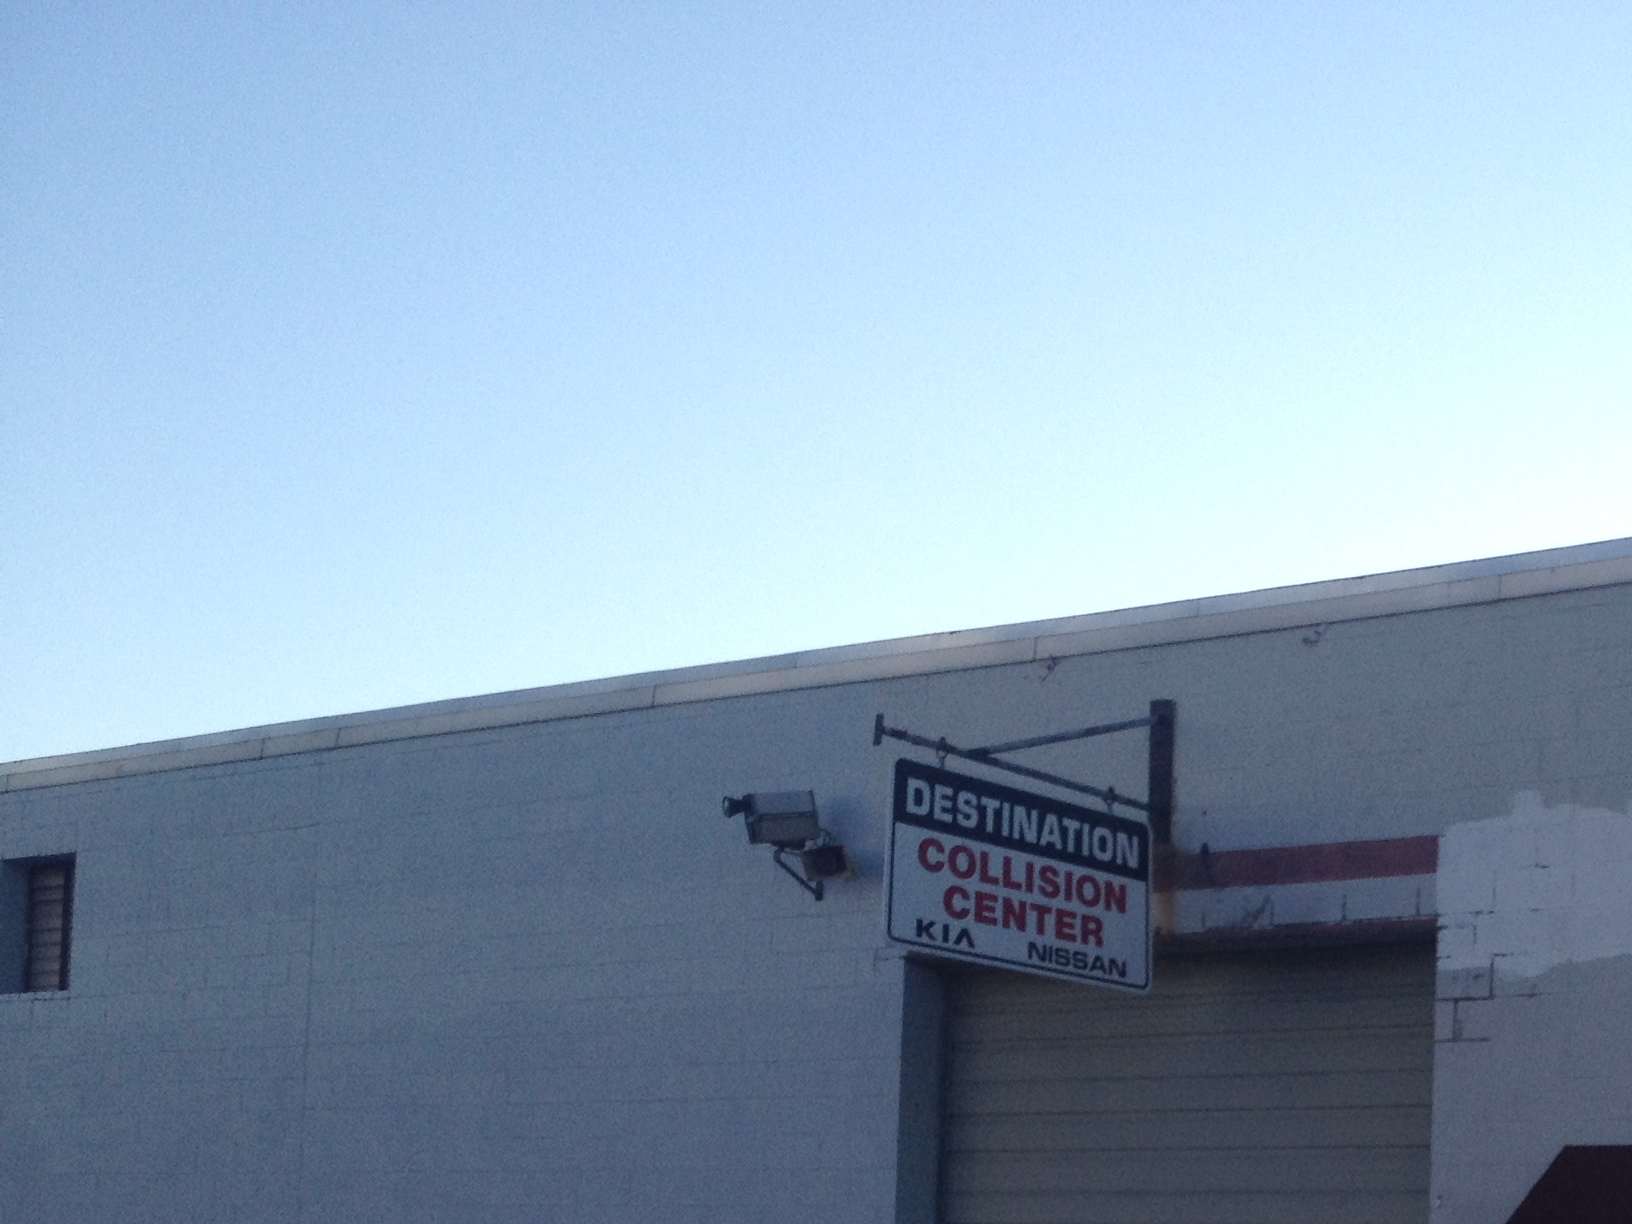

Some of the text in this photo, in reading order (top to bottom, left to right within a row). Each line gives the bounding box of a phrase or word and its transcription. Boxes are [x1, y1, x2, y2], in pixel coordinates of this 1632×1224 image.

[905, 777, 1139, 870] DESTINATION
[917, 838, 1127, 913] COLLISION
[916, 918, 976, 949] KIA
[943, 886, 1104, 947] CENTER
[1027, 941, 1126, 978] NISSAN
